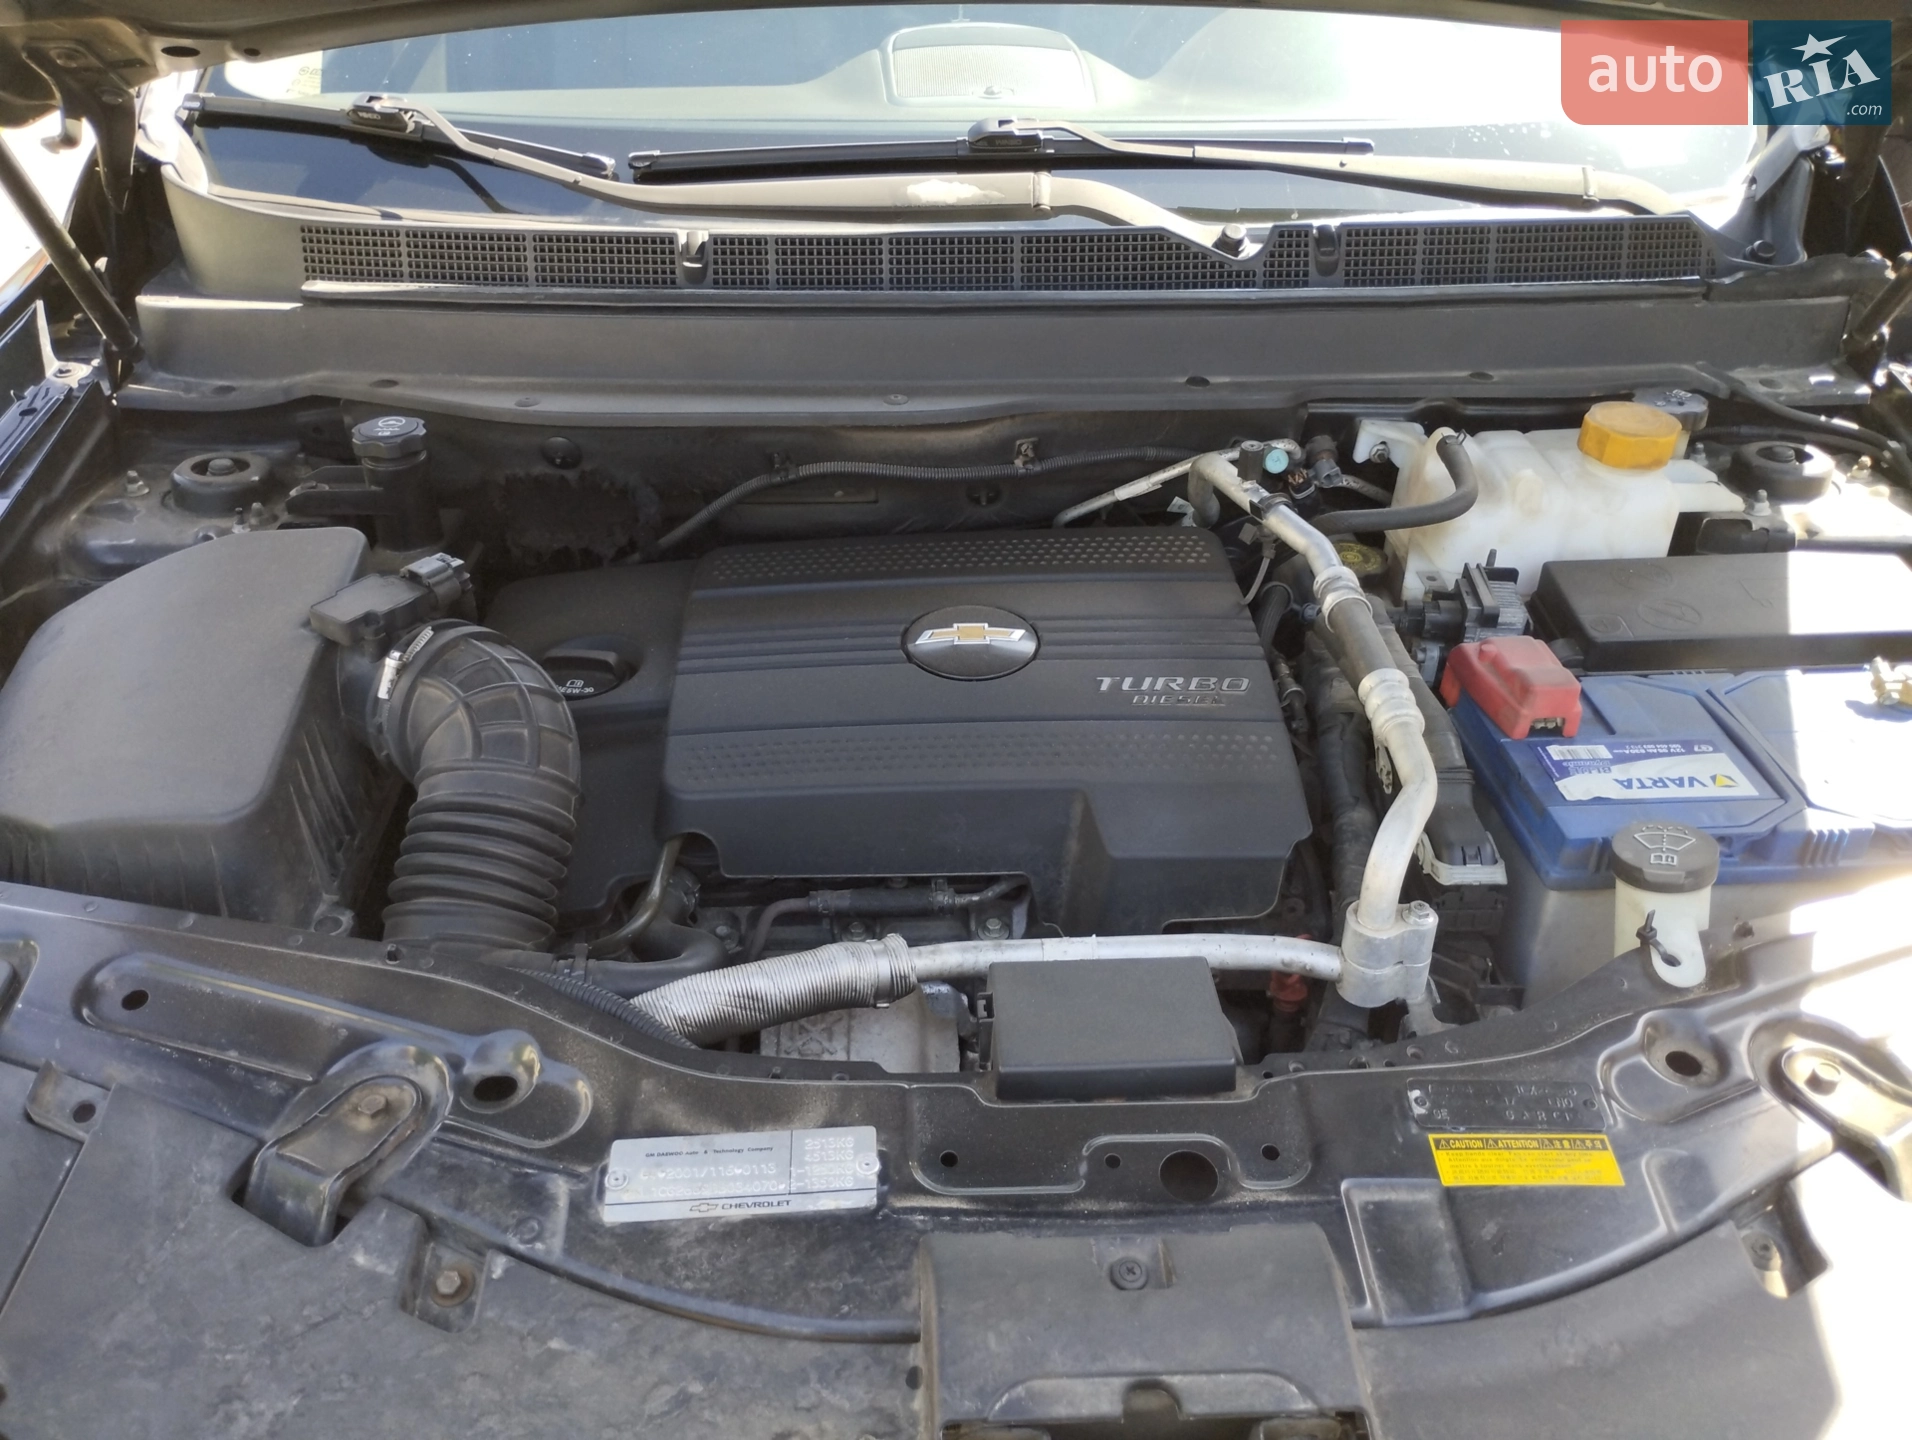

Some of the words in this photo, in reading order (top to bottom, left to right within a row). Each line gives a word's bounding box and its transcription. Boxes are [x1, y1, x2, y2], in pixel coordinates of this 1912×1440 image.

[1096, 676, 1251, 693] TURBO
[1131, 694, 1226, 706] DIESEL
[1612, 776, 1710, 790] VARTA
[1449, 1139, 1484, 1149] CAUTION
[1497, 1139, 1540, 1149] ATTENTION
[721, 1199, 792, 1211] CHEVROLET
